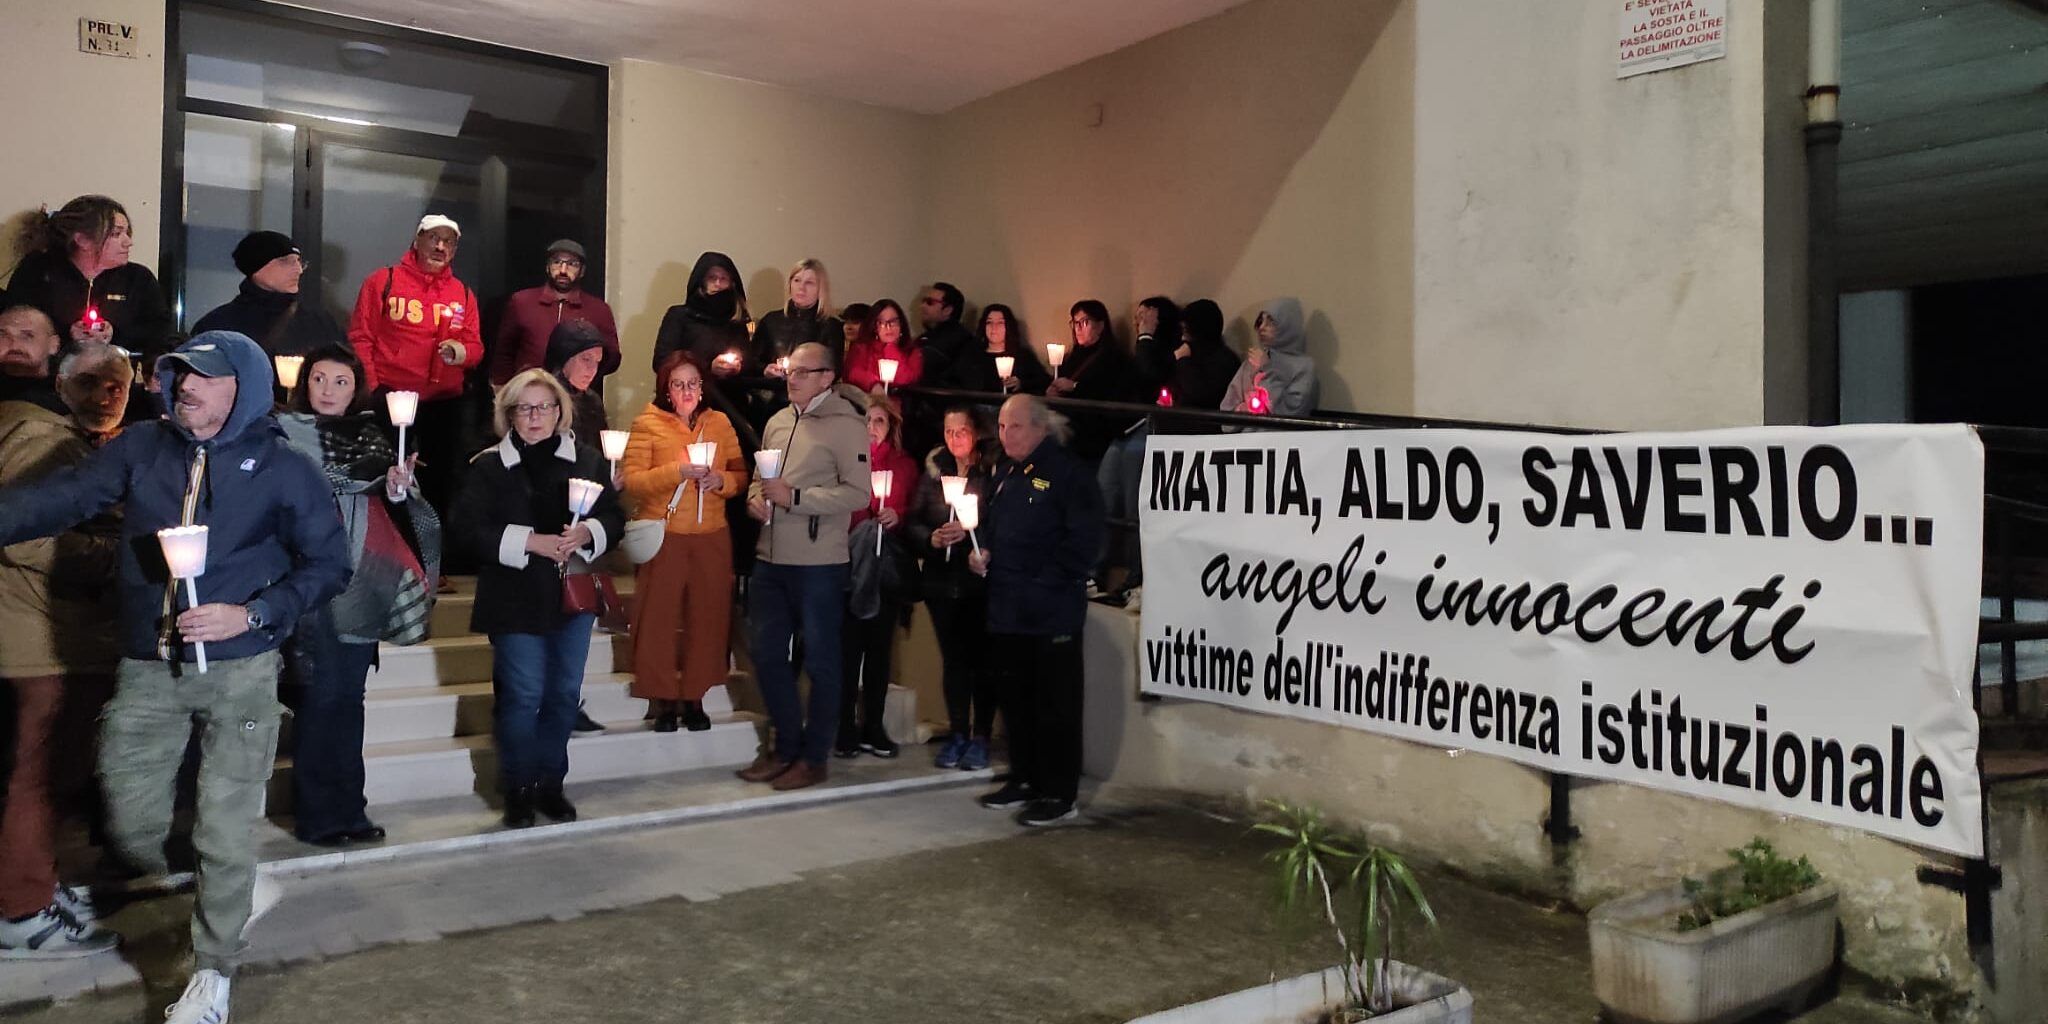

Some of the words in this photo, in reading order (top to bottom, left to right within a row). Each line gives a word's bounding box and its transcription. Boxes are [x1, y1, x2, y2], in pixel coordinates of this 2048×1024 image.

[1633, 22, 1647, 33] LA
[1650, 14, 1686, 29] SOSTA
[1689, 10, 1696, 20] E
[1649, 0, 1693, 17] VIETATA
[1620, 26, 1683, 47] PASSAGGIO
[1686, 17, 1723, 33] OLTRE
[1621, 49, 1634, 60] LA
[1637, 31, 1721, 57] DELIMITAZIONE
[389, 296, 424, 324] US
[1149, 448, 1322, 535] MATTIA,
[1338, 446, 1500, 545] ALDO,
[1521, 444, 1933, 547] SAVERIO...
[1200, 534, 1387, 638] angeli
[1415, 554, 1822, 665] innocenti
[1146, 627, 1254, 697] vittime
[1263, 636, 1561, 756] dell'indifferenza
[1581, 681, 1945, 828] istituzionale
